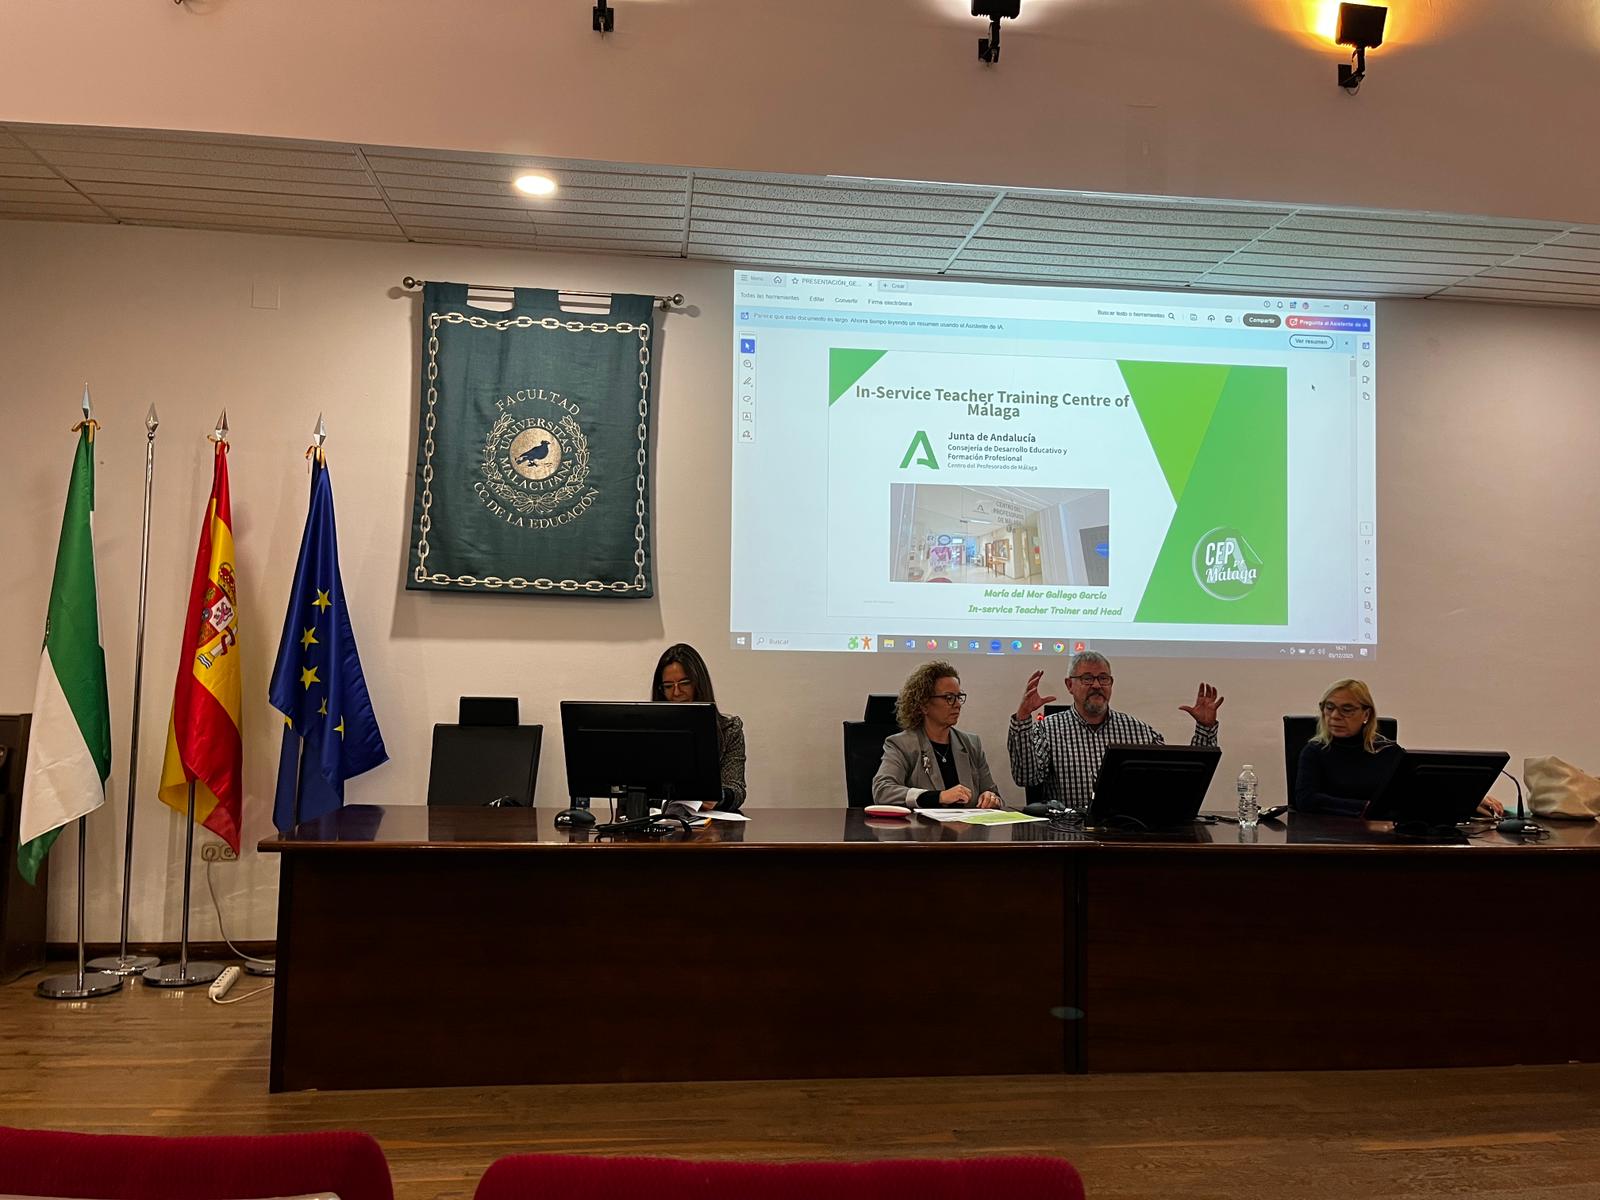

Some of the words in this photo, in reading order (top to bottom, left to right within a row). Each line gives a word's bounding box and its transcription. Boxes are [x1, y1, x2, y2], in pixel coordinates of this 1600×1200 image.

[1249, 316, 1276, 324] Compartir
[495, 389, 581, 416] FACULTAD
[856, 385, 931, 401] In-Service
[934, 387, 994, 403] Teacher
[998, 391, 1058, 408] Training
[1062, 393, 1111, 407] Centre
[1115, 394, 1130, 408] of
[967, 401, 1021, 420] Málaga
[499, 418, 573, 454] UNIVERSITAS
[948, 432, 974, 442] Junta
[977, 432, 989, 442] de
[990, 433, 1036, 443] Andalucía
[947, 444, 983, 454] Consejería
[984, 445, 993, 453] de
[994, 445, 1027, 453] Desarrollo
[1029, 446, 1062, 455] Educativo
[948, 453, 983, 461] Formación
[985, 454, 1023, 462] Profesional
[499, 457, 573, 491] MALACITANA
[487, 499, 504, 518] DE
[507, 512, 523, 528] LA
[529, 487, 600, 529] EDUCACIÓN
[1205, 541, 1234, 566] CEP
[1205, 566, 1257, 583] Málaga
[984, 589, 1009, 599] María
[1011, 589, 1024, 599] del
[1026, 591, 1043, 600] Mar
[1045, 591, 1077, 601] Gallego
[1079, 591, 1107, 600] García
[968, 605, 1012, 614] In-service
[1015, 605, 1048, 615] Teacher
[1050, 606, 1080, 615] Trainer
[1082, 607, 1098, 616] and
[1100, 607, 1122, 616] Head
